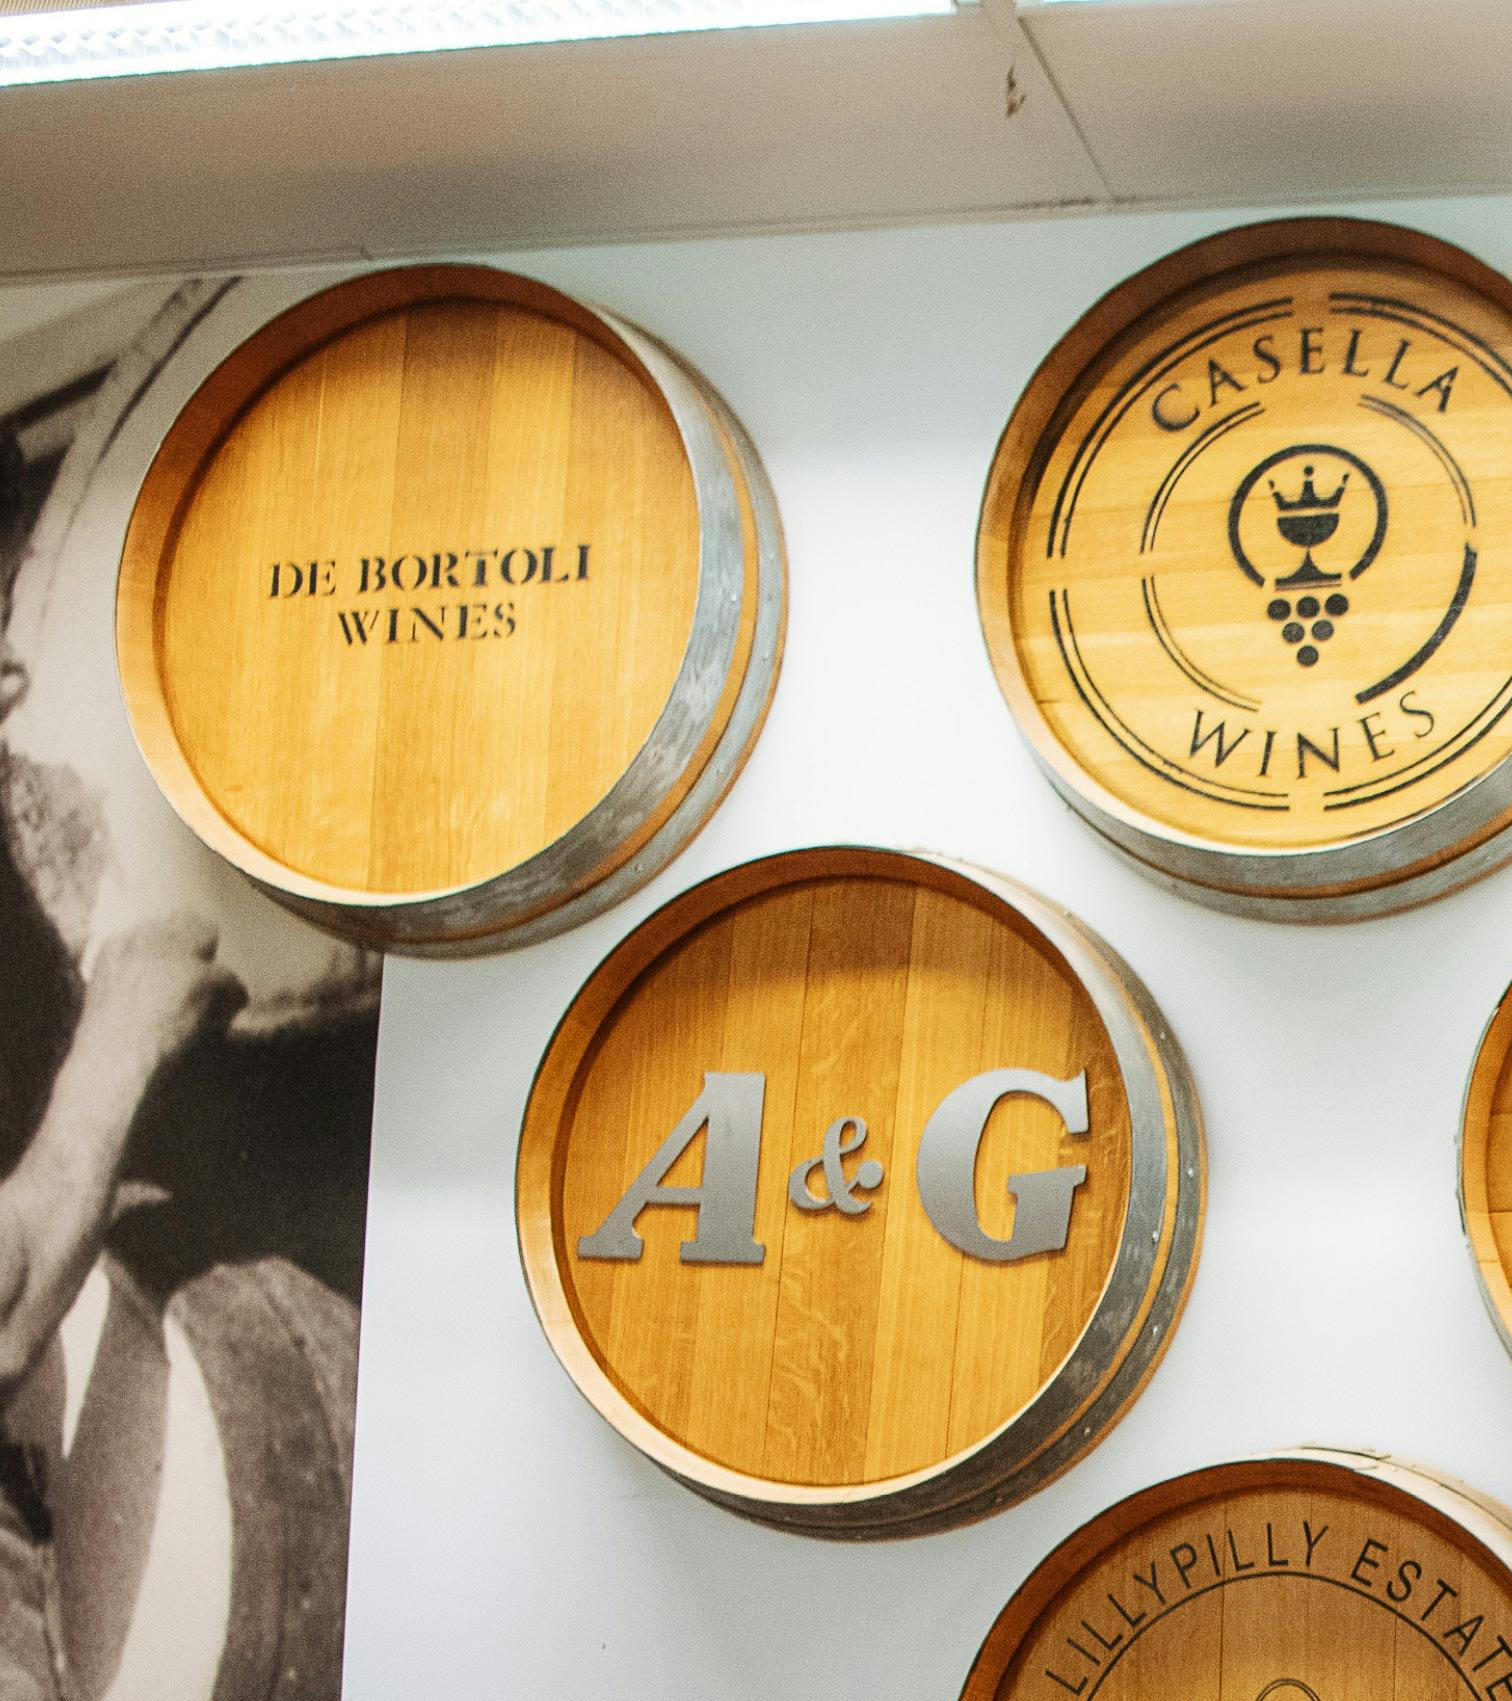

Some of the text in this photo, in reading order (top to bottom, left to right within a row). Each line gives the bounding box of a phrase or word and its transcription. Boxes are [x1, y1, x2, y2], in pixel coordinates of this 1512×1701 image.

[1150, 326, 1462, 433] CASELLA
[269, 543, 593, 599] DE BORTOLI
[338, 601, 517, 647] WINES
[1187, 690, 1436, 779] WINES
[577, 1067, 1089, 1265] A & G
[1044, 1521, 1329, 1698] LILLYPILLY
